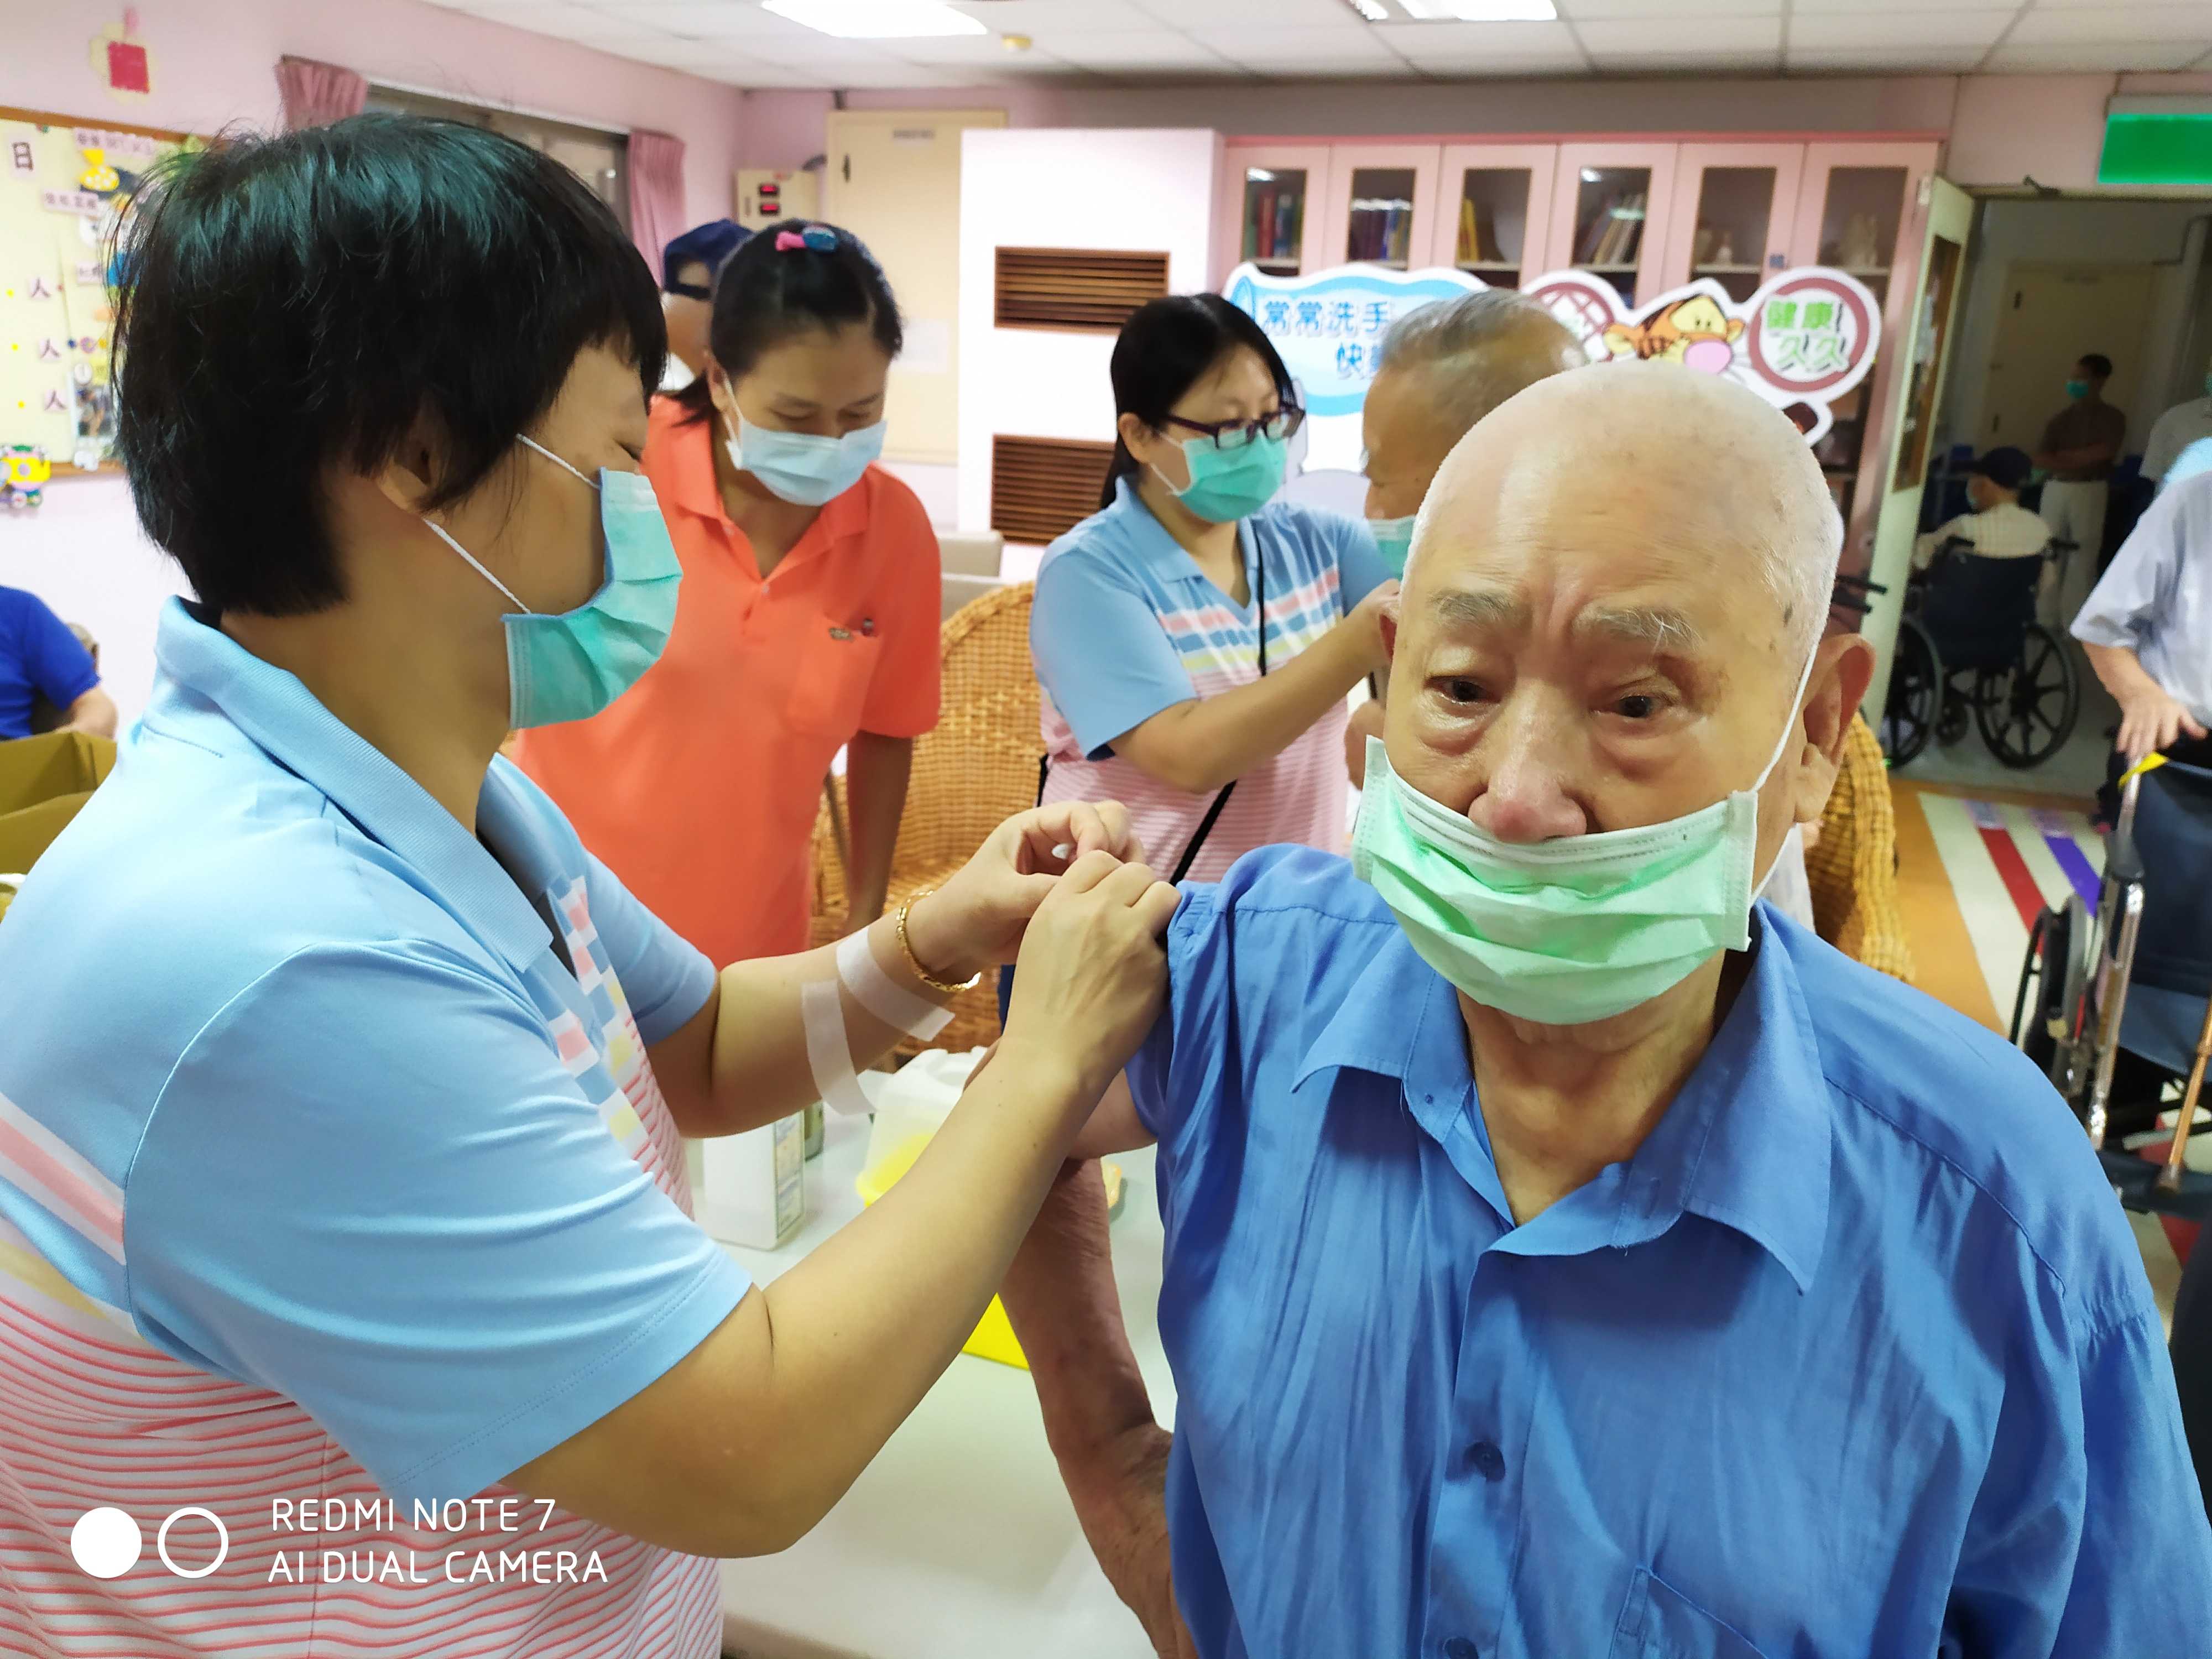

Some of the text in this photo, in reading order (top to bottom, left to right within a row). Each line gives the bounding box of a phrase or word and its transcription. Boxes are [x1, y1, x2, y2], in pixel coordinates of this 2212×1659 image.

[12, 141, 34, 171] 日
[30, 276, 51, 299] 人
[1264, 300, 1389, 333] 常常洗手
[40, 338, 60, 359] 人
[1777, 336, 1844, 367] 久久
[44, 389, 67, 411] 人
